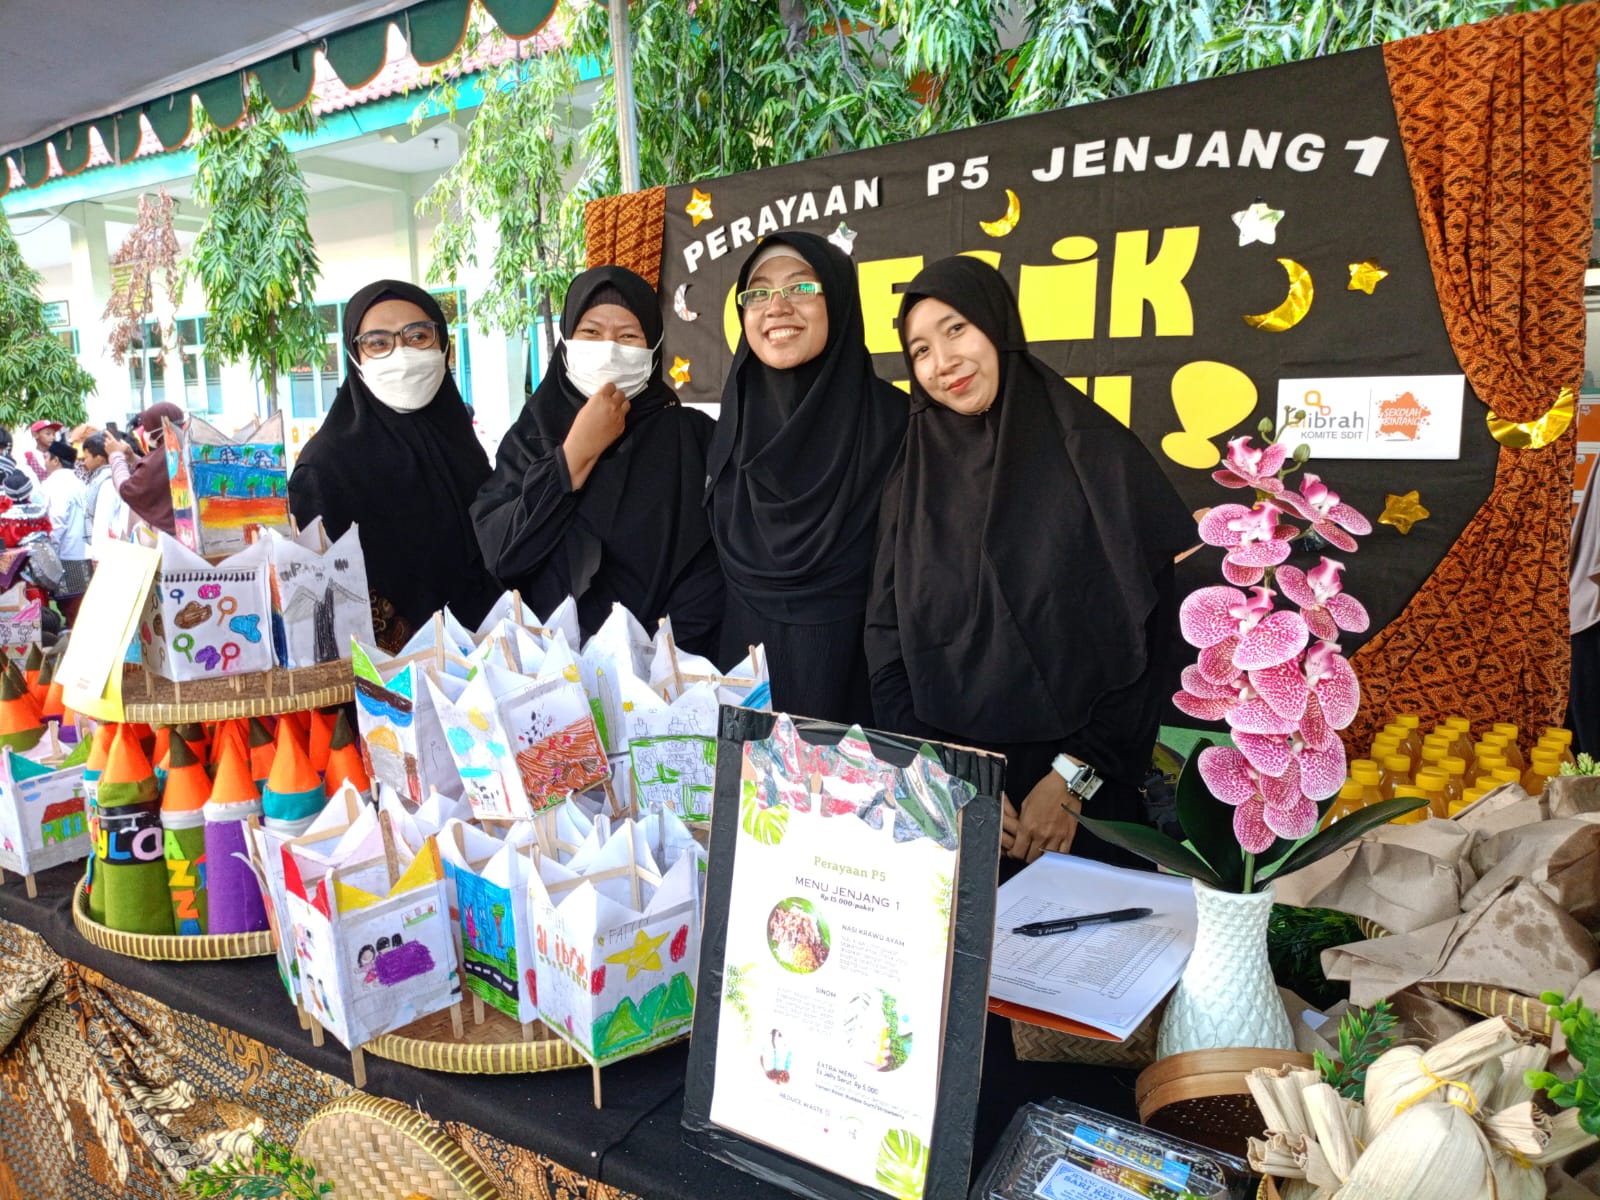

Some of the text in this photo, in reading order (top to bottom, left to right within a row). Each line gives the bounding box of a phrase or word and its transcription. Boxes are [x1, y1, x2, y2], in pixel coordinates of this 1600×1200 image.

[682, 129, 1390, 273] PERAYAAN P5 JENJANG 1
[1384, 407, 1423, 418] SEKOLAH
[1301, 431, 1364, 440] KOMITE SDIT
[814, 856, 886, 882] Perayaan P5
[795, 876, 829, 892] MENU
[832, 886, 890, 908] JENJANG
[841, 924, 858, 934] NASI
[886, 936, 905, 947] AYAM
[817, 1061, 858, 1080] EXTRA MENU
[803, 1102, 823, 1114] WASTE
